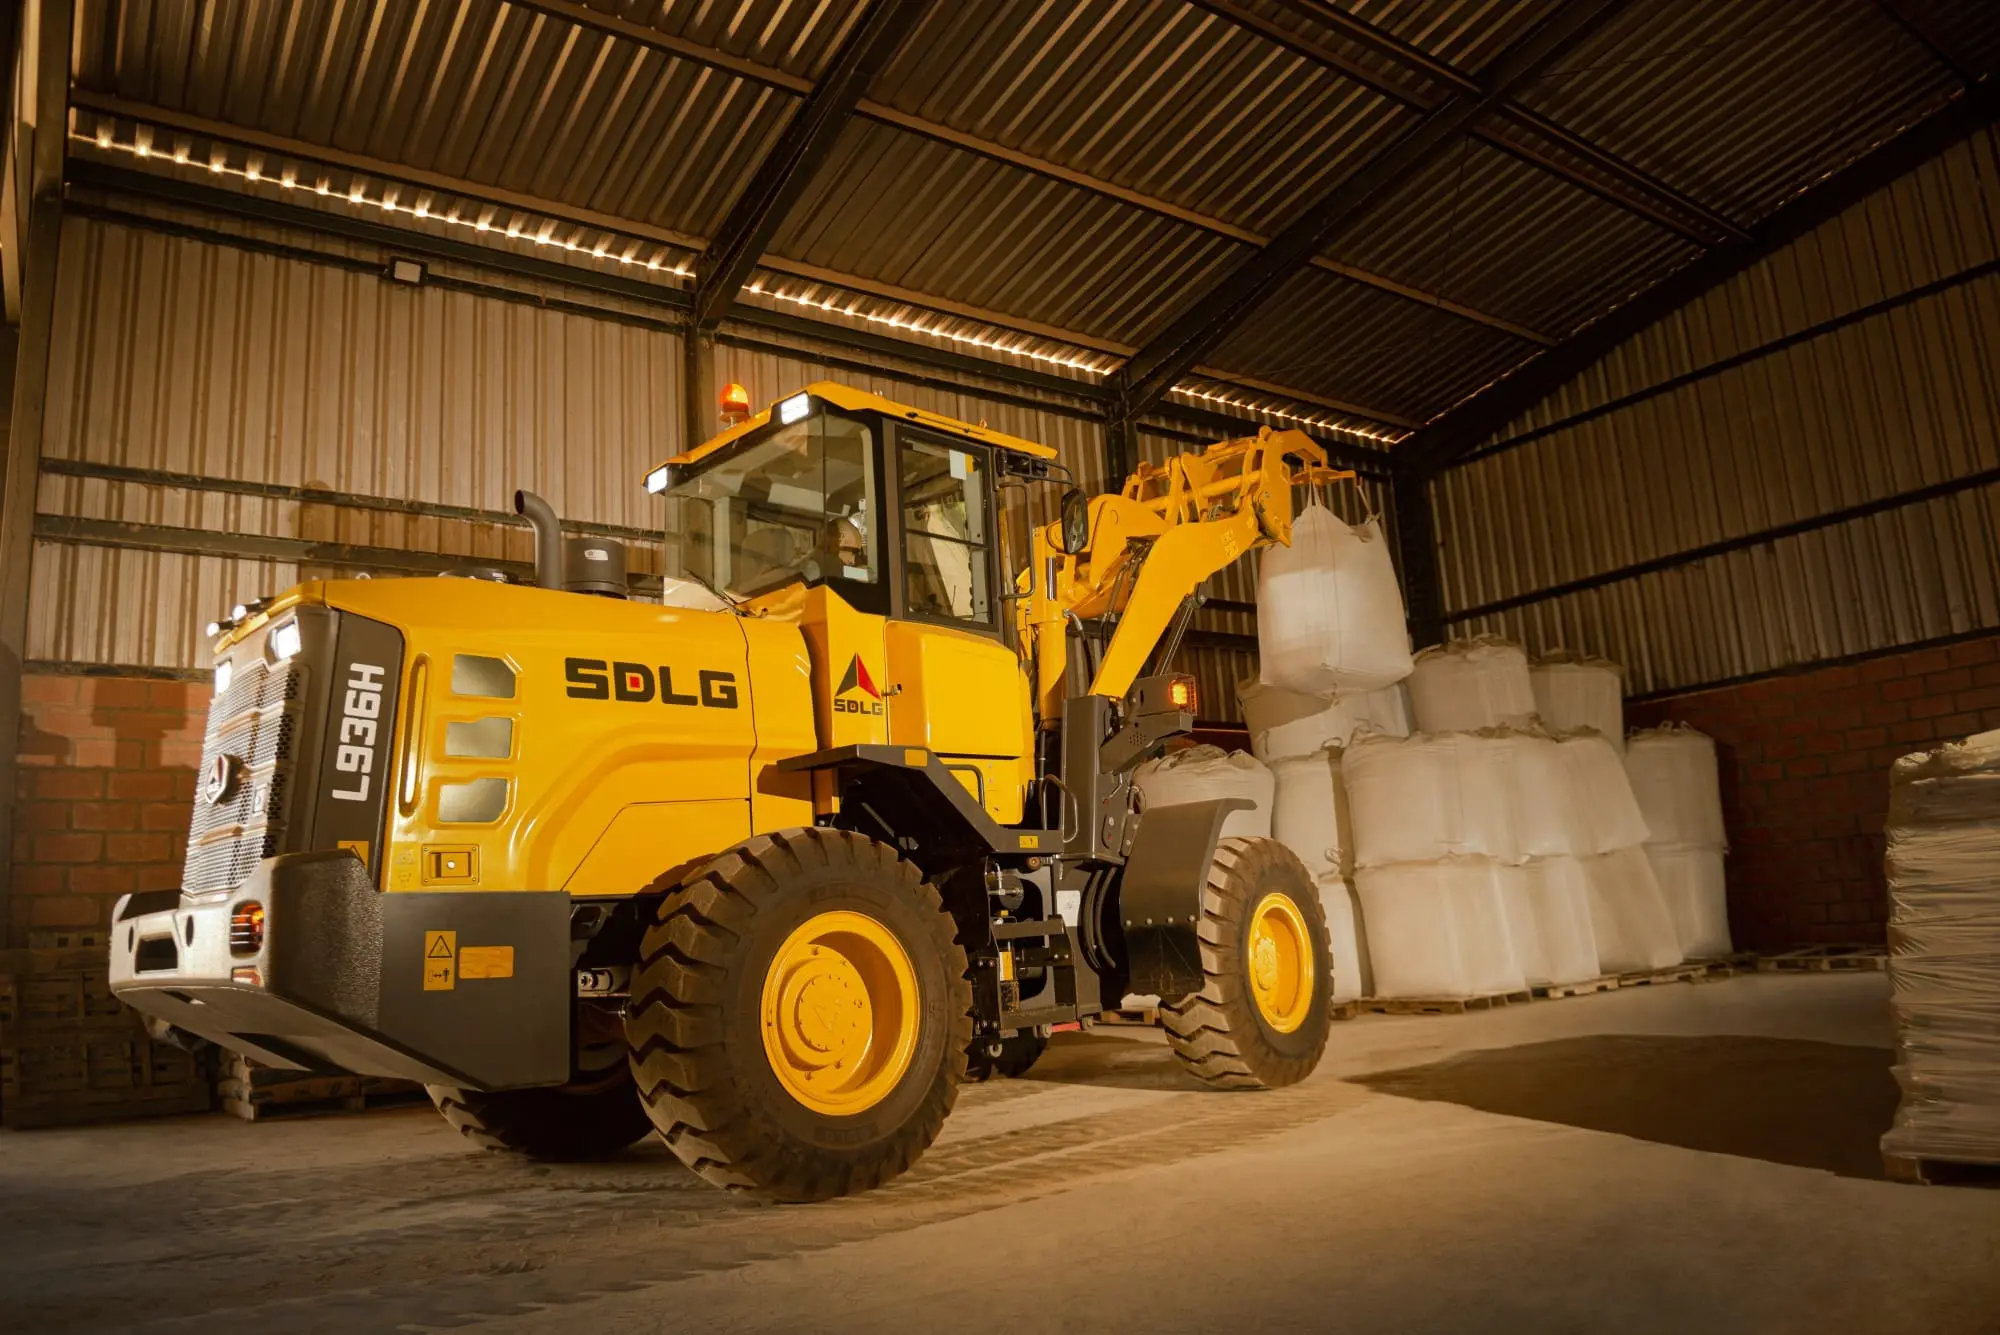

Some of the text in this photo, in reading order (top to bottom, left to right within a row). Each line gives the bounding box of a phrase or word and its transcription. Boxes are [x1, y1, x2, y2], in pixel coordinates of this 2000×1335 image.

[564, 657, 738, 709] SDLG
[833, 698, 883, 716] SDLG
[332, 662, 385, 802] L936H
